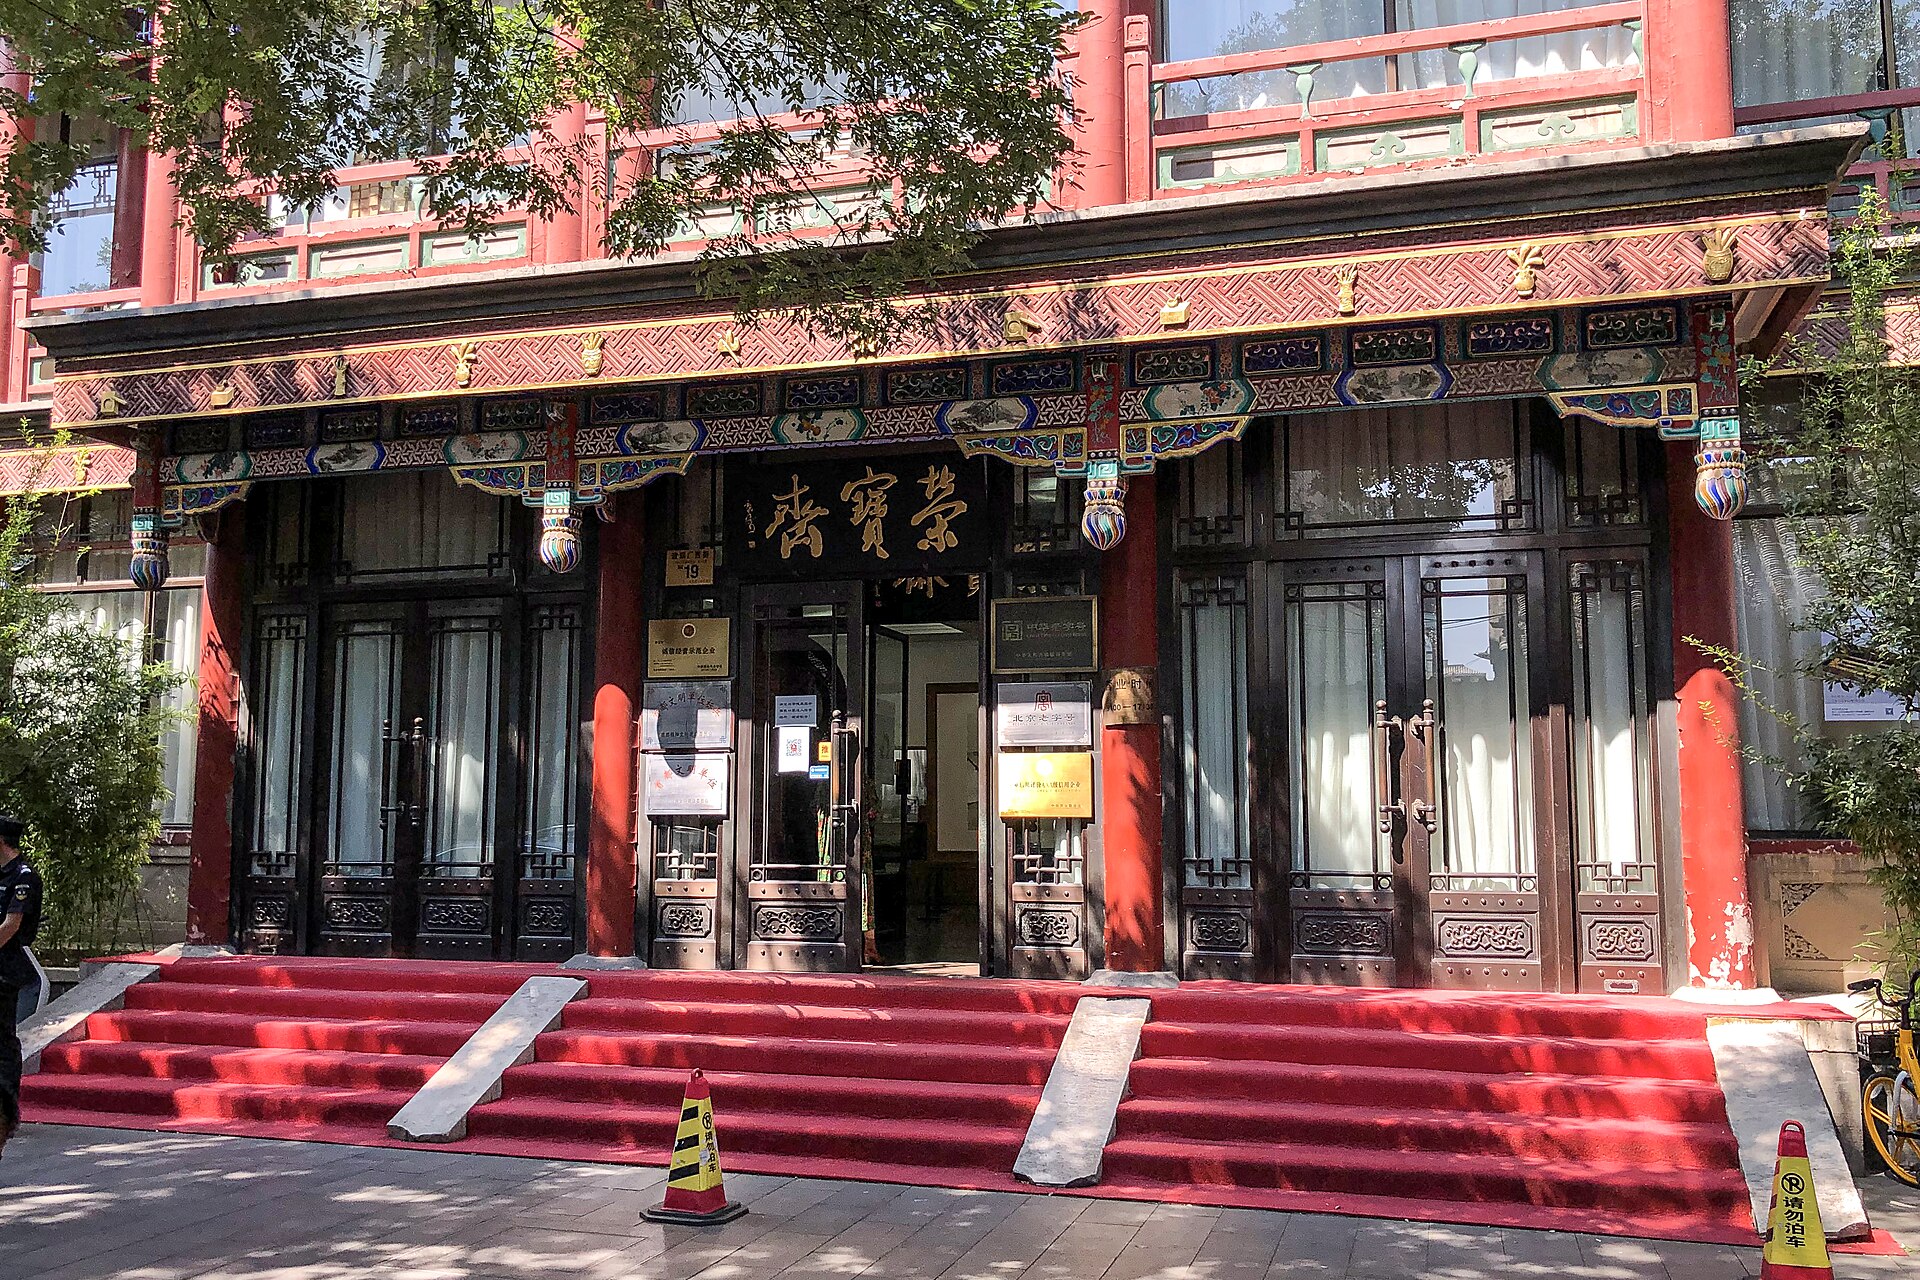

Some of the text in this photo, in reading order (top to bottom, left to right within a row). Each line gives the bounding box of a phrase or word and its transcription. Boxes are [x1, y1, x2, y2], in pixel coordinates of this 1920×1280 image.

[1012, 713, 1075, 722] 北京老字号
[655, 764, 717, 790] 文明单位
[705, 1131, 716, 1172] 请勿泊车
[1783, 1196, 1806, 1248] 请勿泊车
